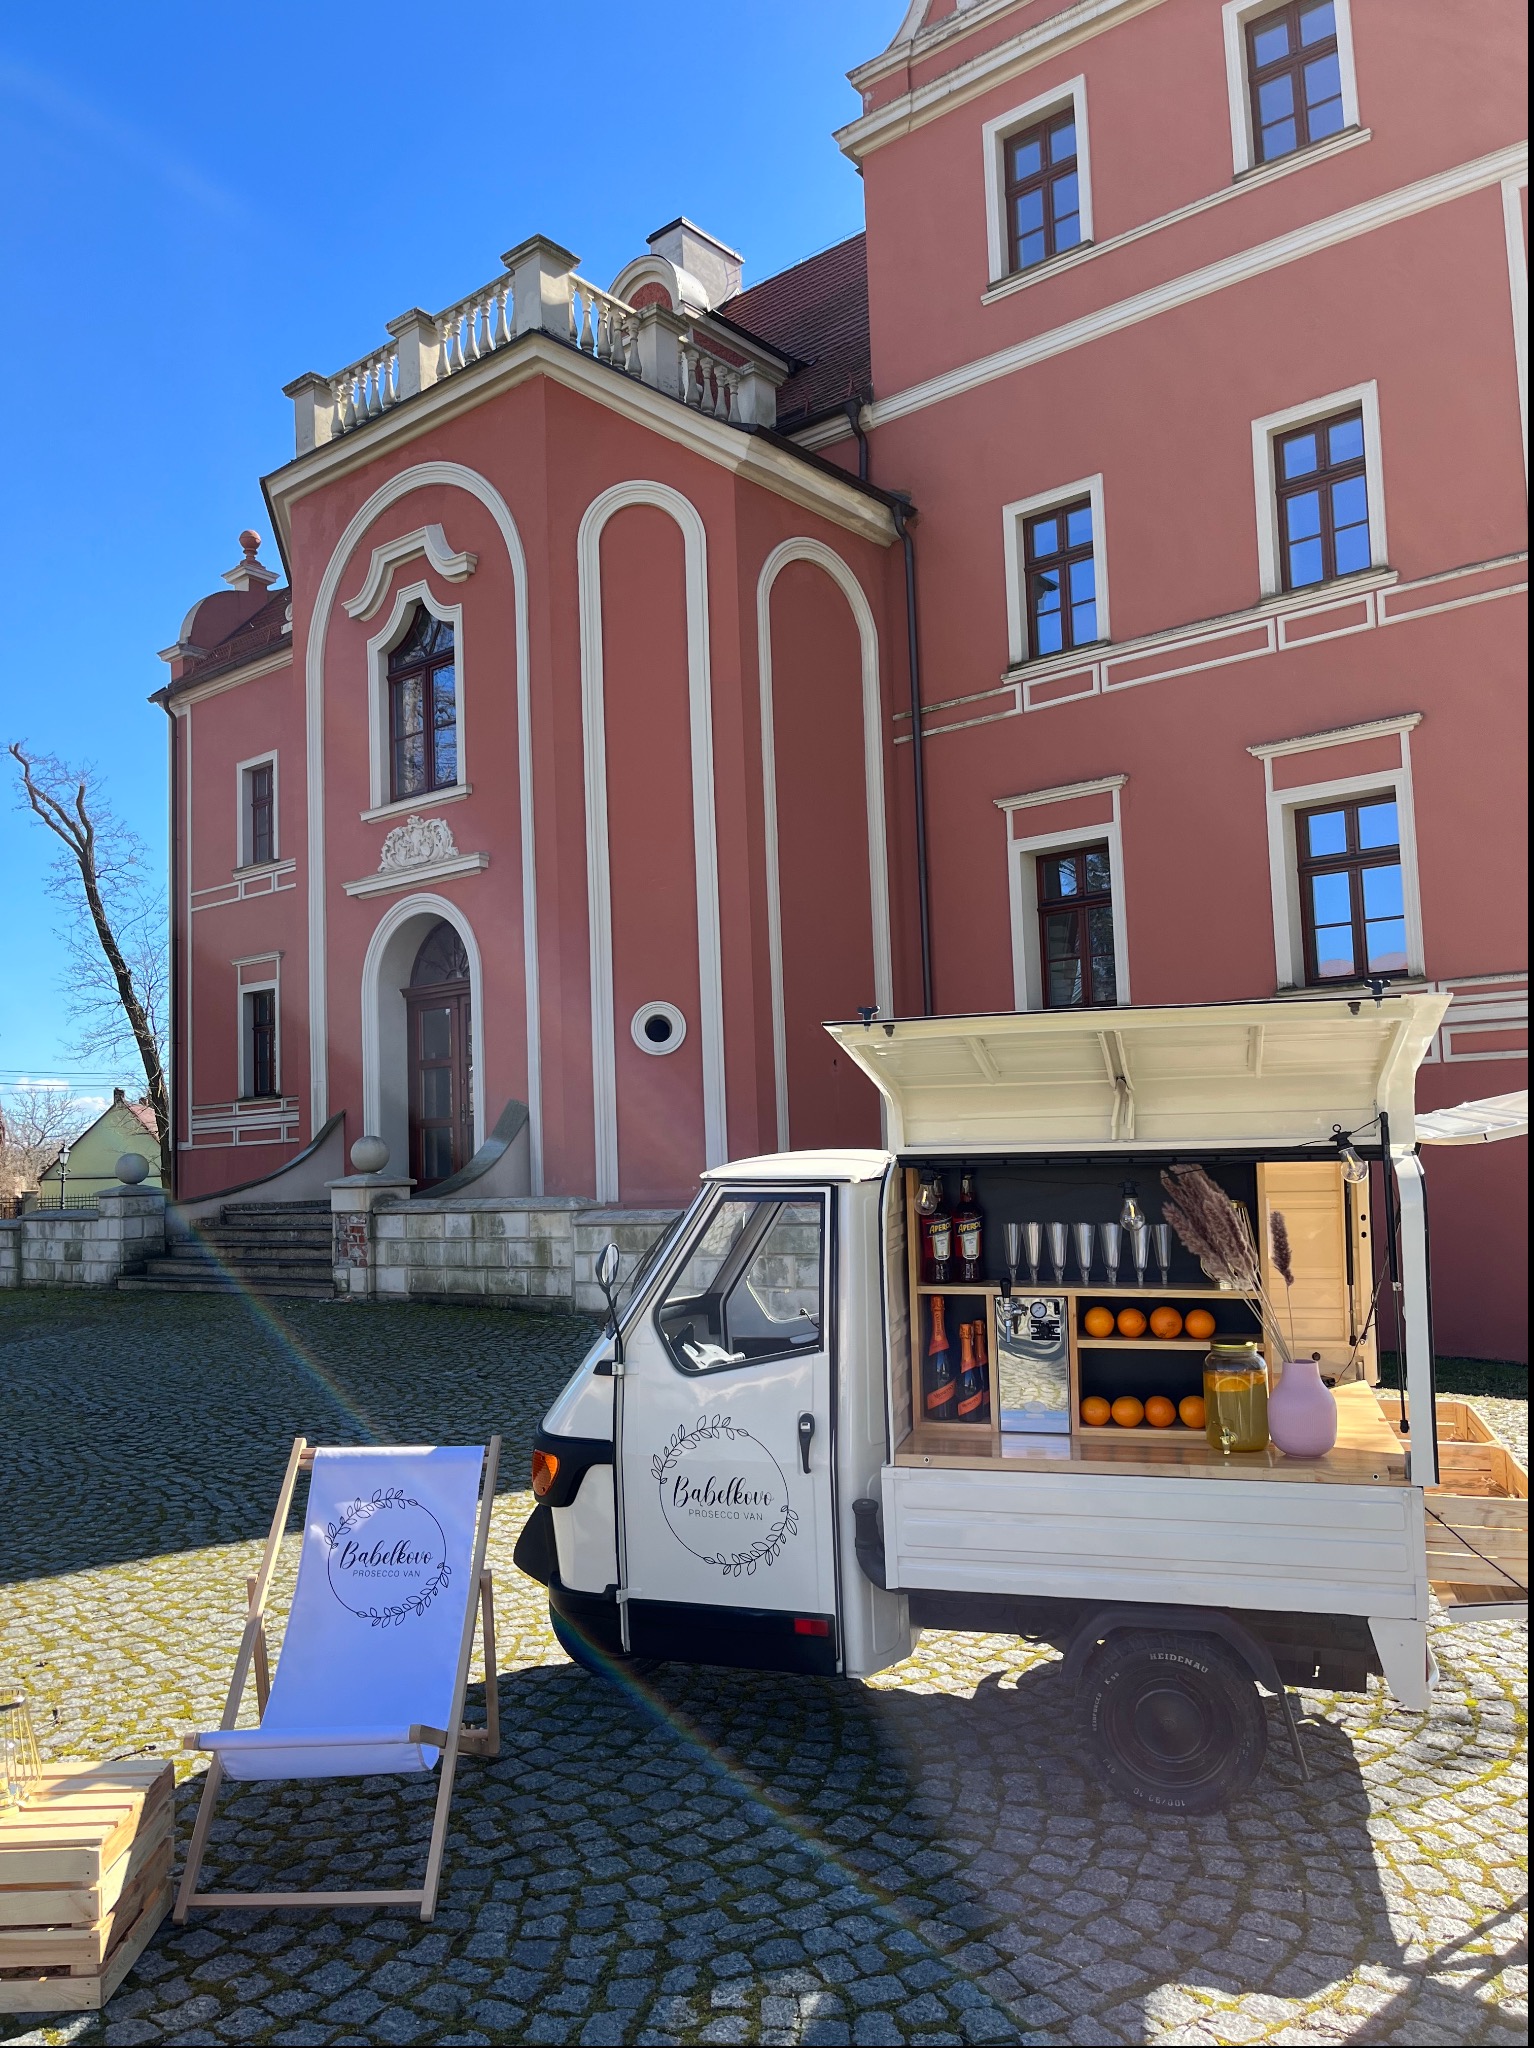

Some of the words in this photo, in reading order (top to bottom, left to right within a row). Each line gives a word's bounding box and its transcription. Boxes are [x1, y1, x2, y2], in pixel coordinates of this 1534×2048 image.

[929, 1222, 951, 1234] APEROL
[958, 1221, 981, 1233] APEROL
[688, 1509, 740, 1520] PROSECCO
[743, 1512, 763, 1520] VAN
[352, 1569, 400, 1577] PROSECCO
[1149, 1652, 1209, 1674] HEIDENAU
